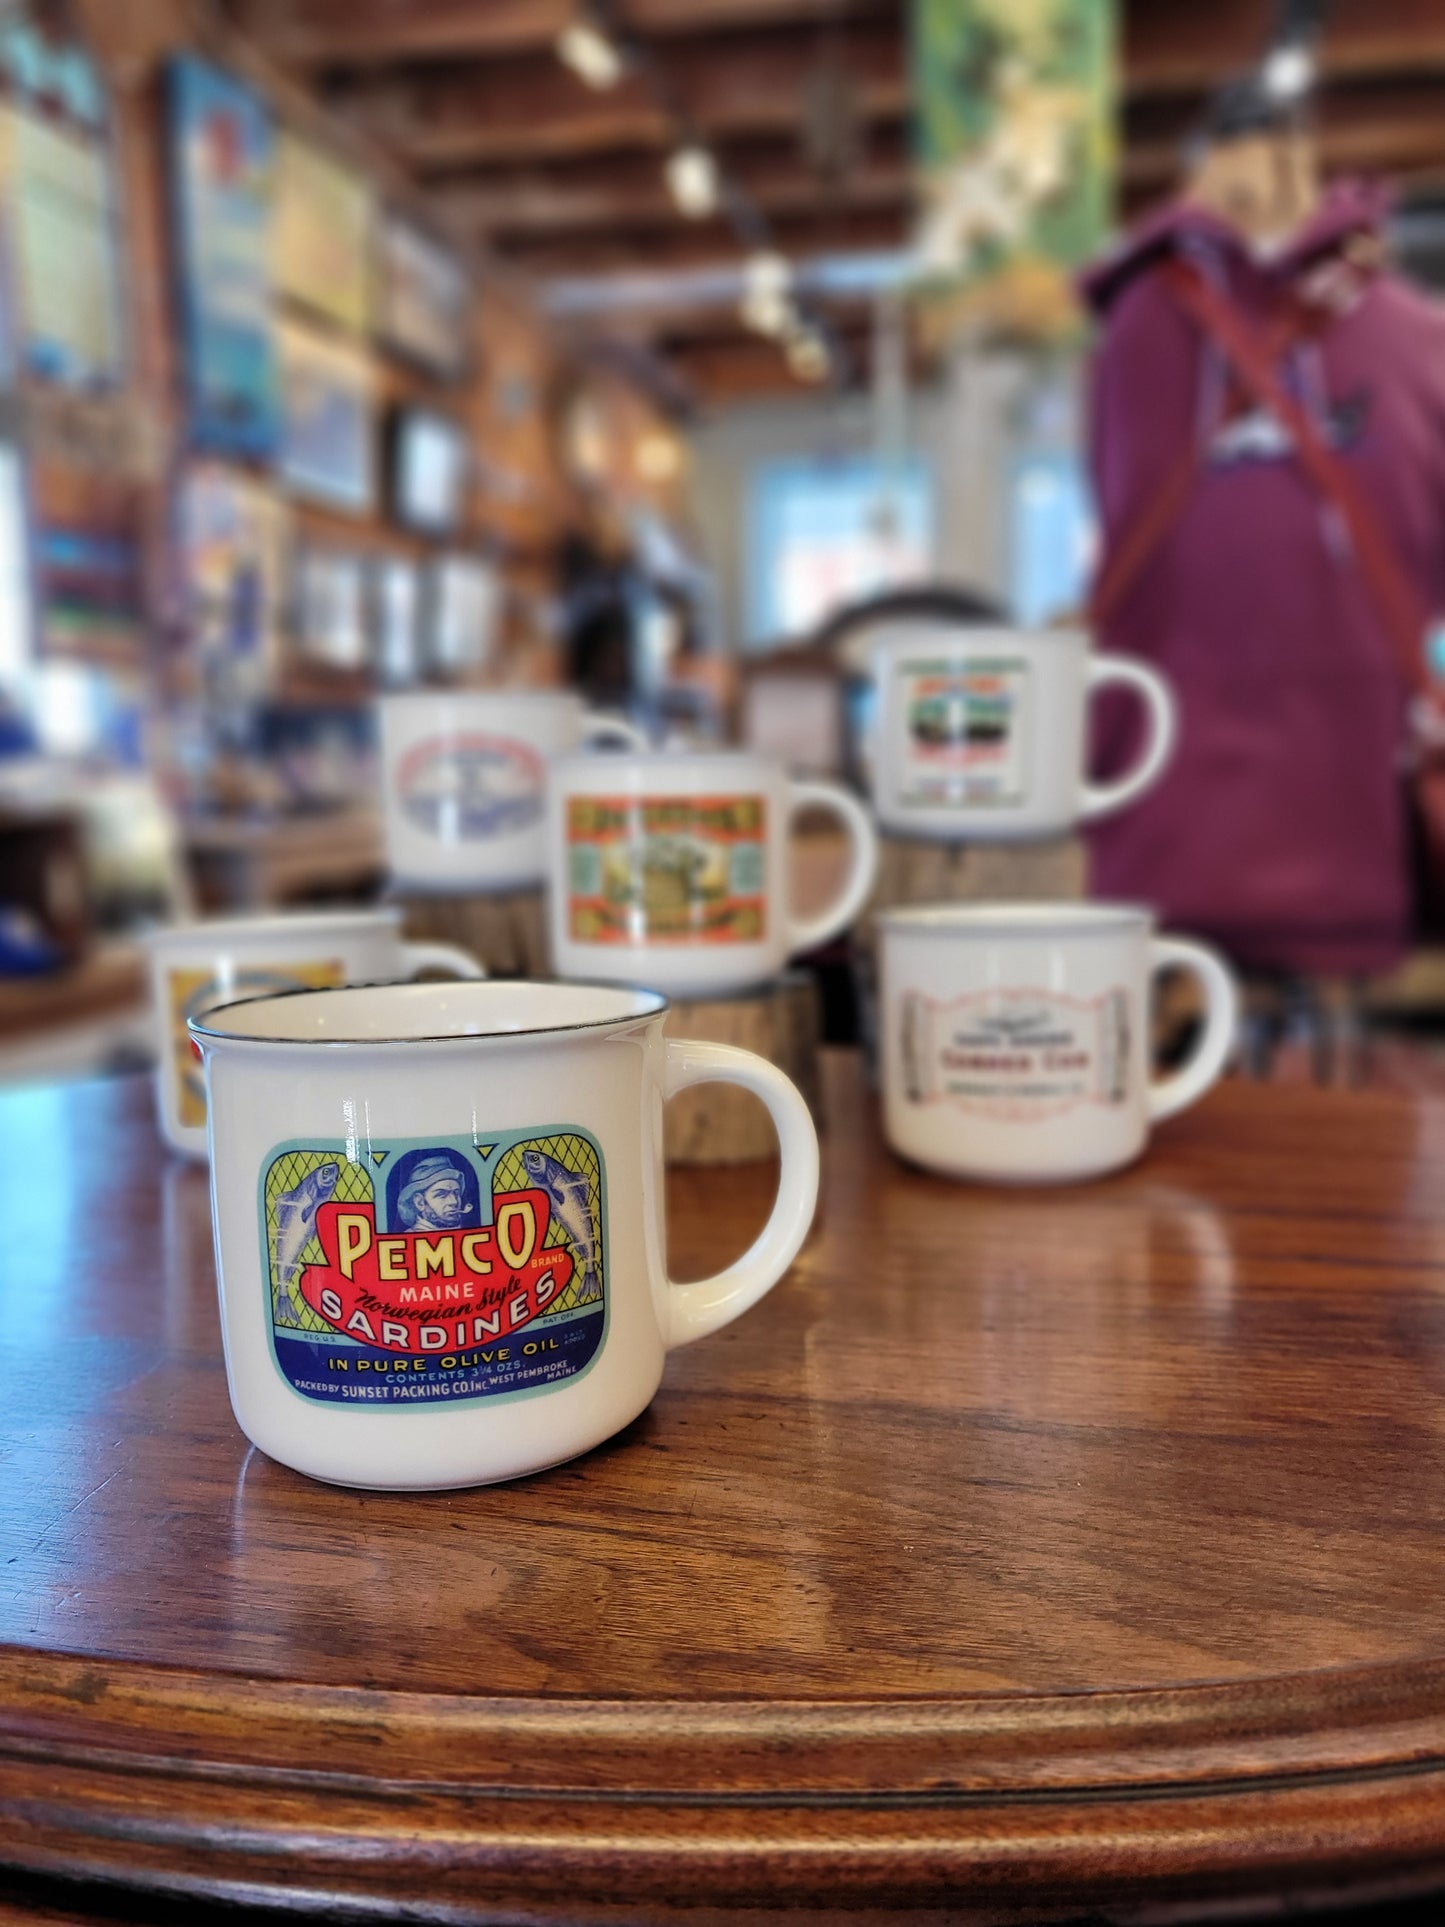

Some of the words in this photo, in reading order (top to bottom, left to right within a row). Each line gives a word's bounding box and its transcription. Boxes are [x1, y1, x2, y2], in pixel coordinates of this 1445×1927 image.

[336, 1200, 537, 1281] PEMCO
[531, 1253, 565, 1269] BRAND
[320, 1269, 556, 1350] SARDINES
[353, 1287, 473, 1323] Norwegian
[476, 1275, 522, 1306] Style
[399, 1282, 475, 1303] MAINE
[328, 1358, 349, 1371] IN
[357, 1358, 427, 1373] PURE
[440, 1347, 511, 1370] OLIVE
[522, 1337, 559, 1356] OIL
[546, 1365, 577, 1381] MAINE
[341, 1384, 389, 1399] SUNSET
[393, 1382, 450, 1398] PACKING
[489, 1372, 515, 1386] WEST
[517, 1359, 568, 1380] PEMBROKE
[385, 1368, 465, 1384] CONTENTS
